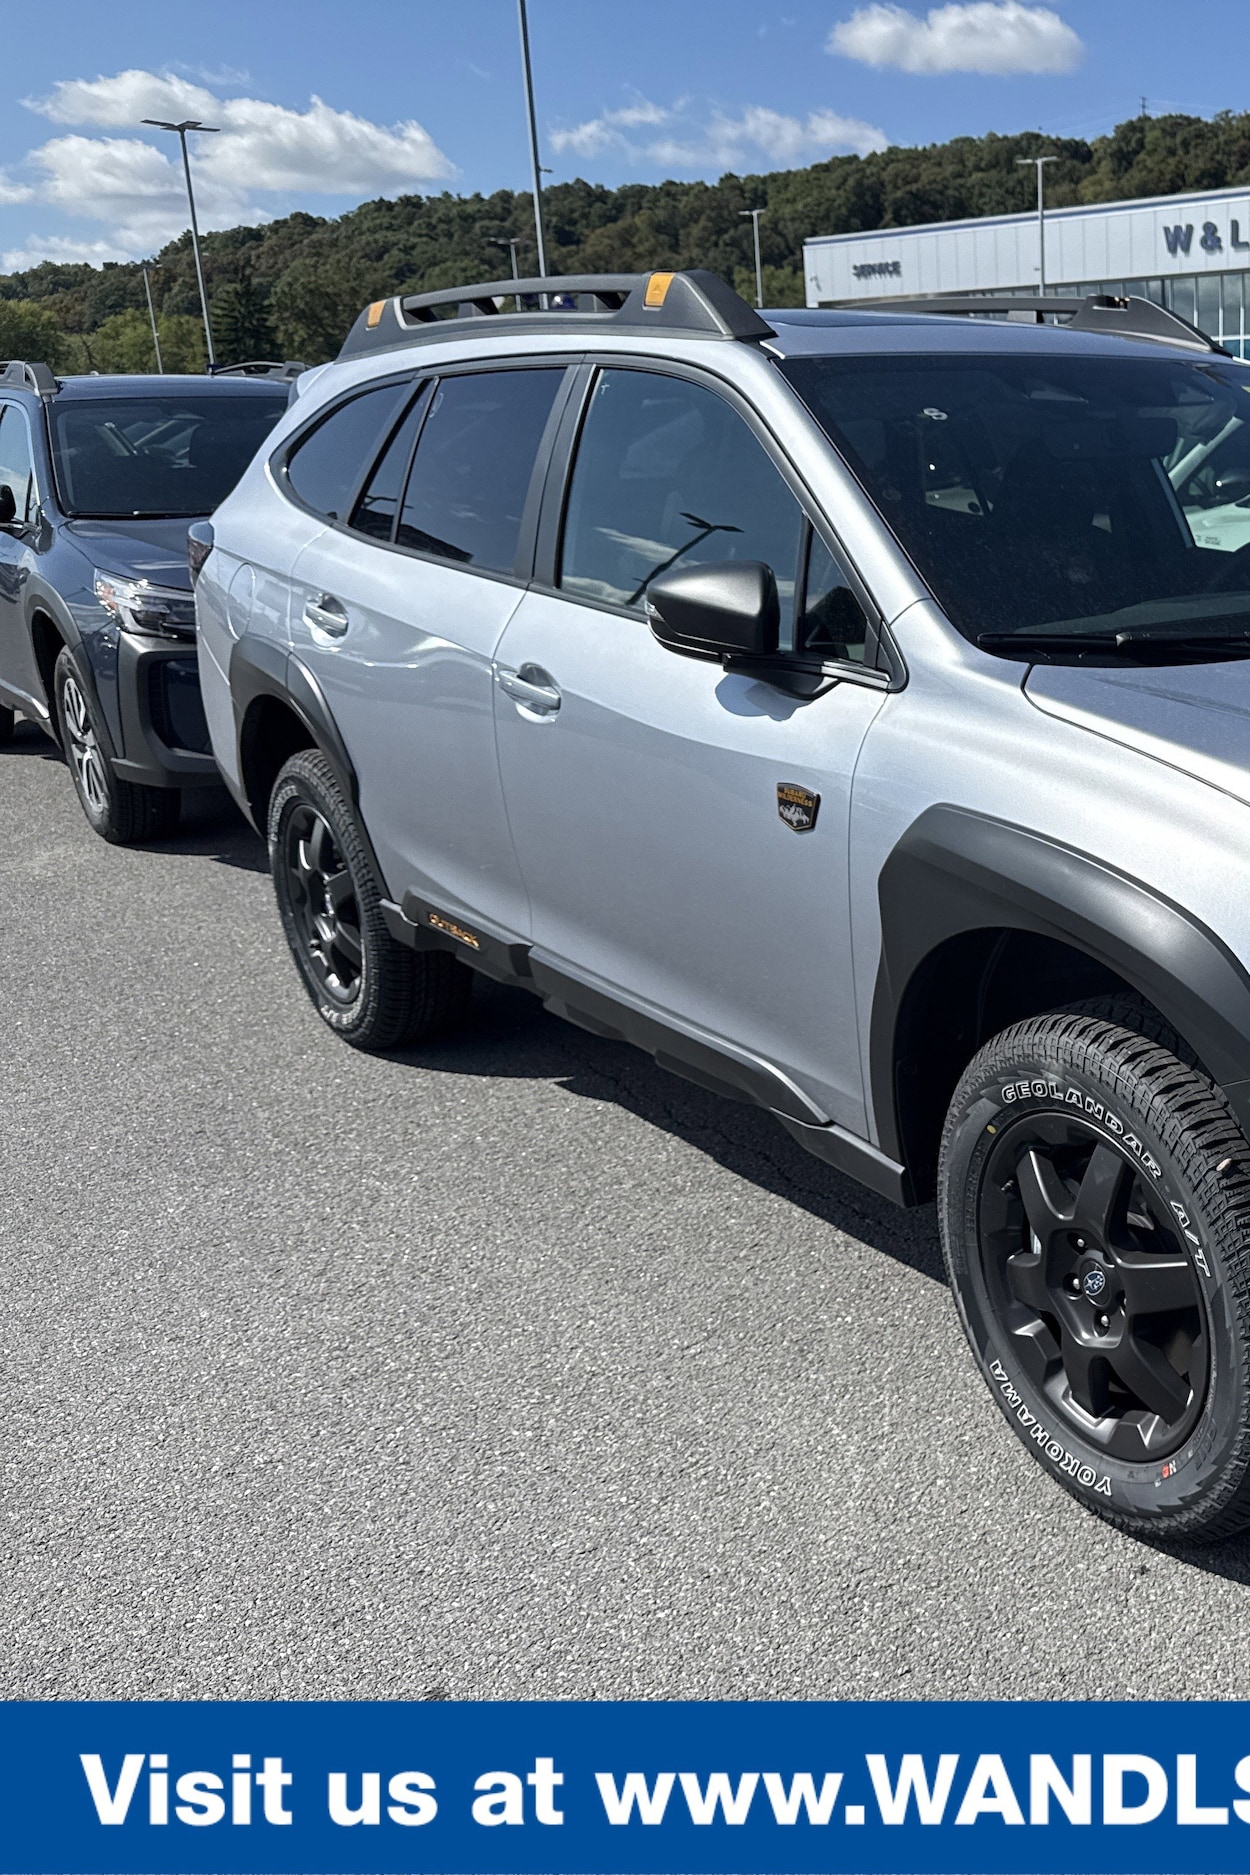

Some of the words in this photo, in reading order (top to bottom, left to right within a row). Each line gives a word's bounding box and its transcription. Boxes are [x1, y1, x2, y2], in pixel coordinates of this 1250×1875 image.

[1163, 223, 1193, 255] W
[1200, 221, 1222, 252] &
[1230, 219, 1250, 250] L
[1001, 1079, 1162, 1180] GEOLANDAR
[1170, 1200, 1212, 1278] A/T
[989, 1359, 1113, 1497] YOKOHAMA
